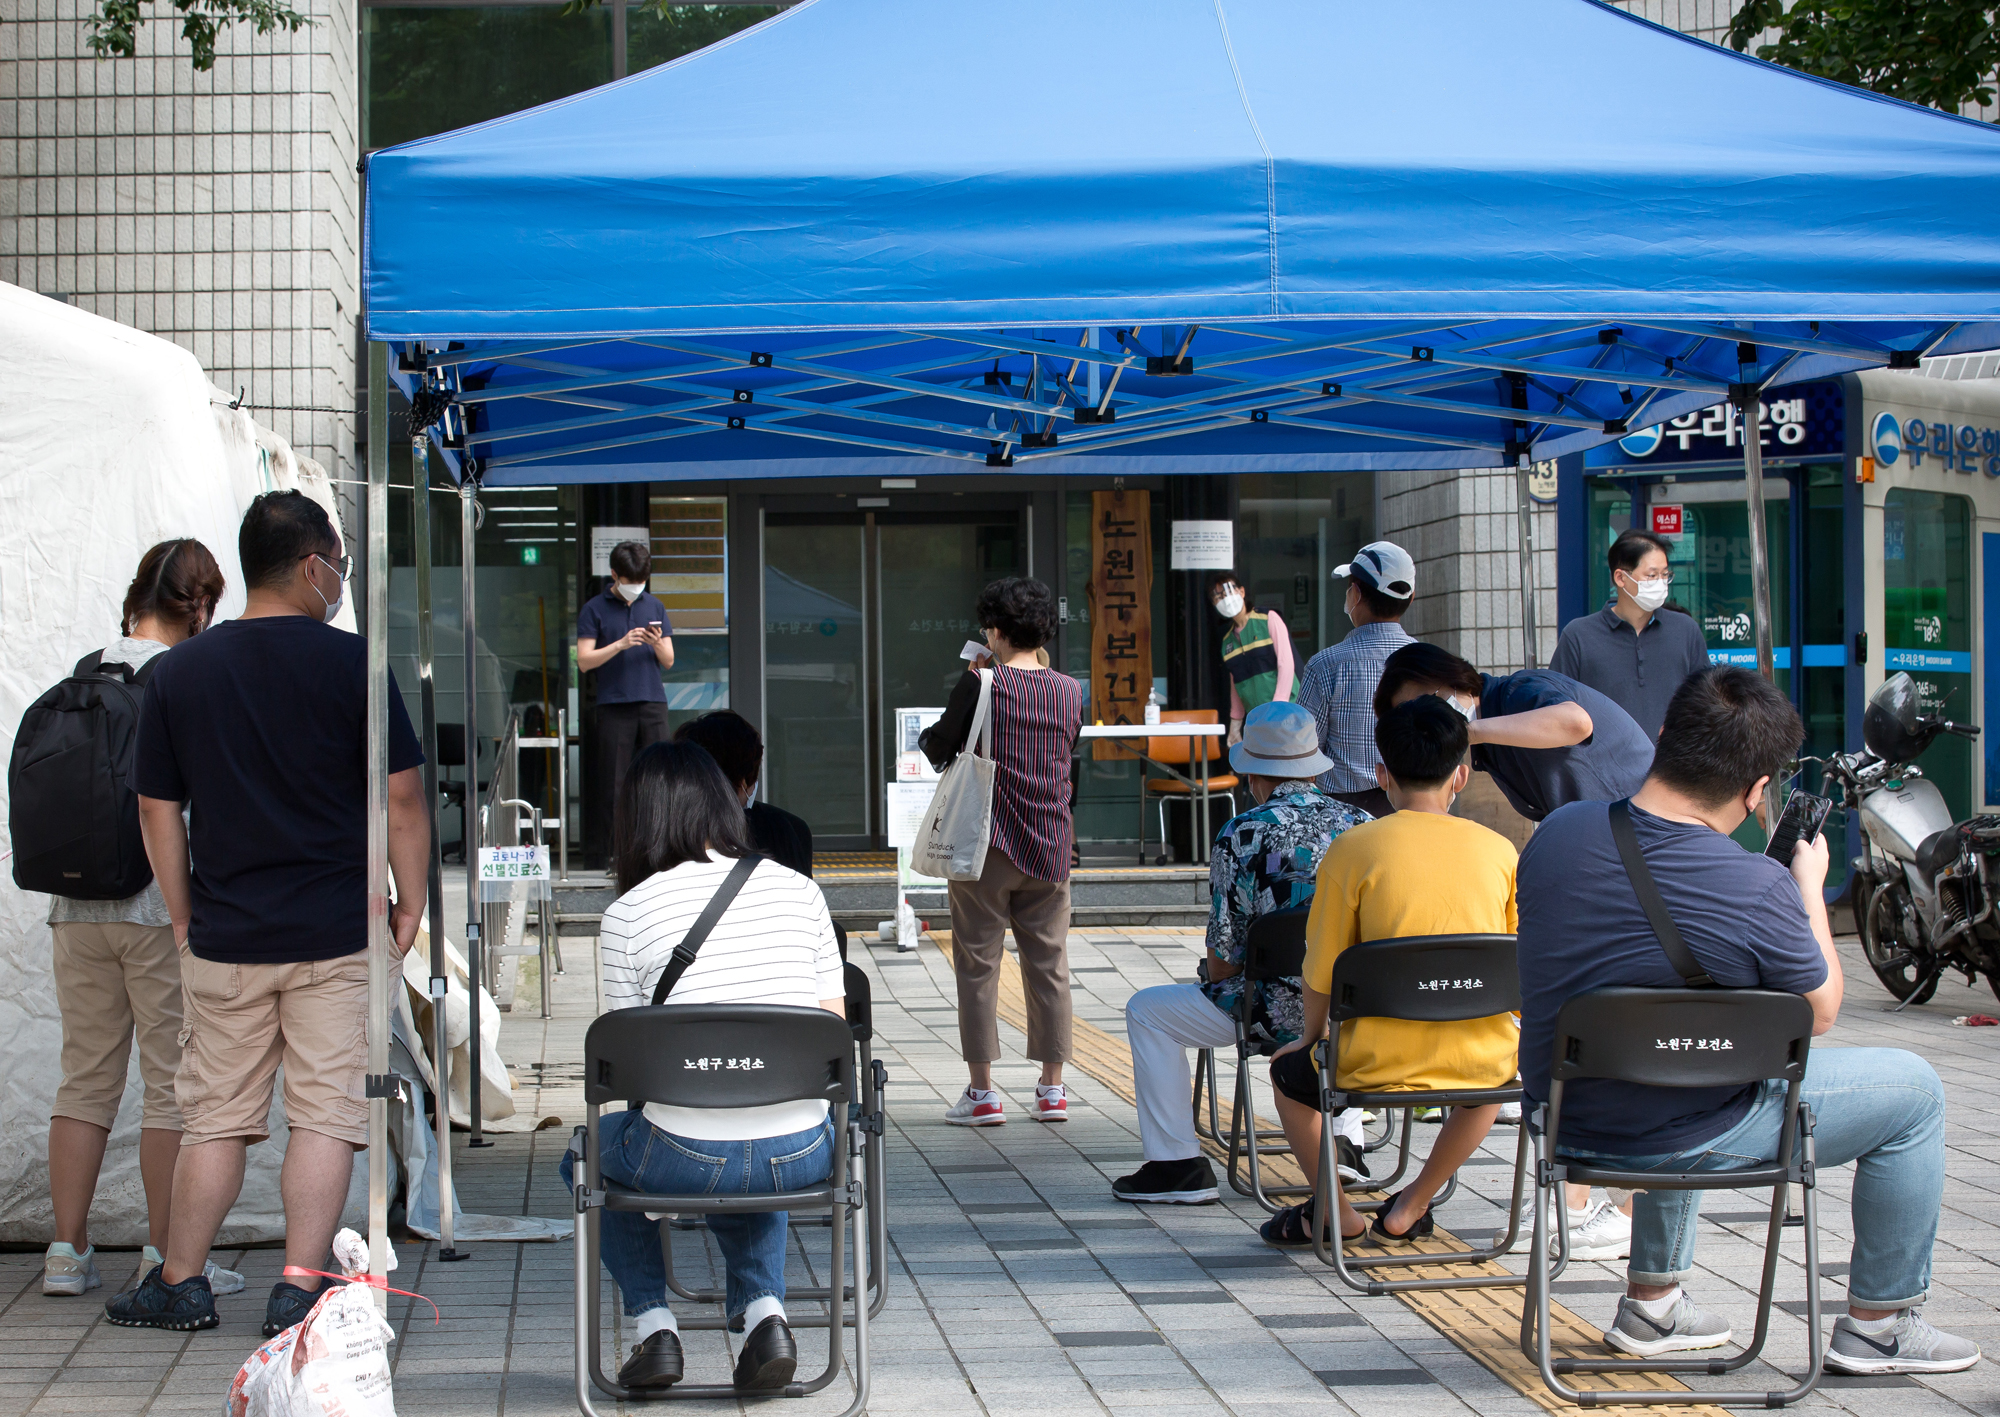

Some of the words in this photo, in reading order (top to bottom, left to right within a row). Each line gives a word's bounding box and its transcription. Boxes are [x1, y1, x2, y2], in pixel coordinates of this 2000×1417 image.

[1657, 514, 1677, 525] 에스원
[1731, 654, 1756, 663] WOORI
[1900, 653, 1925, 667] 우리은행
[928, 841, 955, 852] Sunduck
[482, 863, 543, 878] 선별진료소
[1418, 979, 1450, 991] 노원구
[1452, 978, 1484, 990] 보건소
[1655, 1037, 1694, 1051] 노원구
[1696, 1038, 1734, 1051] 보건소
[683, 1057, 723, 1071] 노원구
[725, 1057, 765, 1071] 보건소
[346, 1351, 360, 1359] Cung
